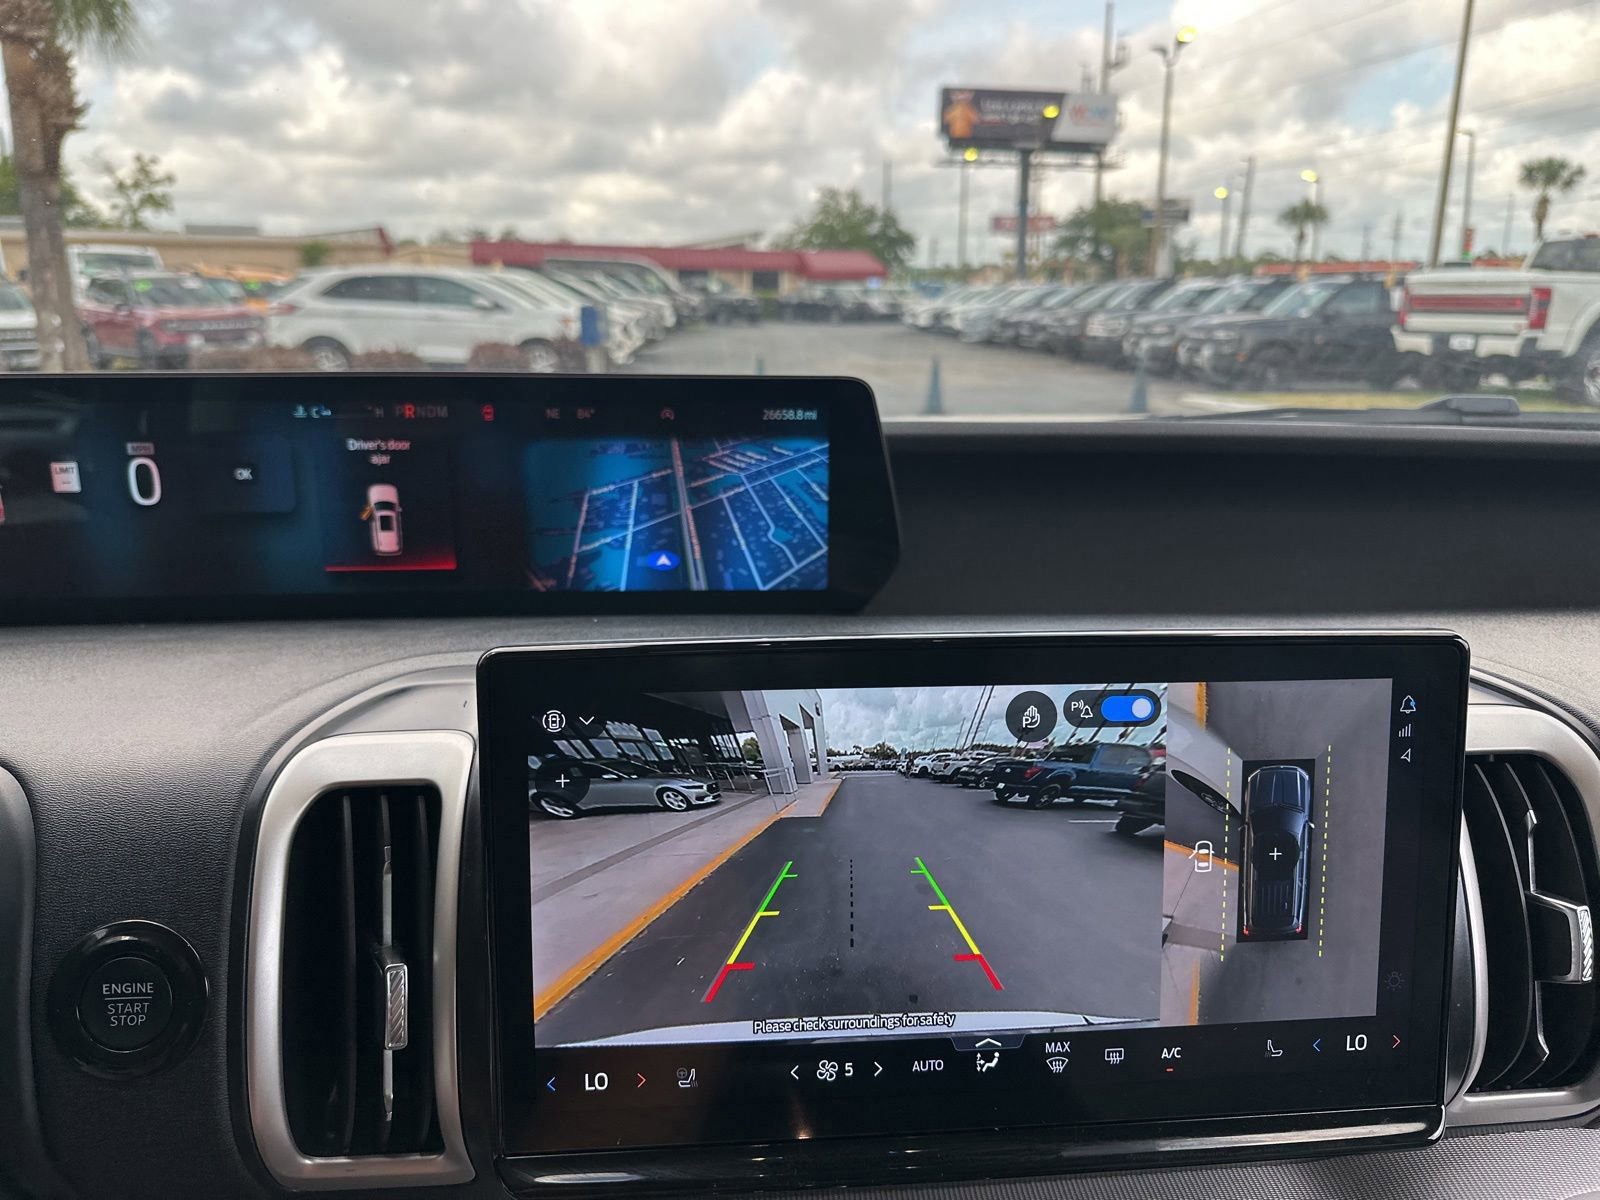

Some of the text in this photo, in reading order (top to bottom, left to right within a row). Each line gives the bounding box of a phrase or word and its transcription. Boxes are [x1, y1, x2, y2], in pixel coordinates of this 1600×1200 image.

[763, 409, 803, 421] 26658.8
[346, 438, 411, 451] Driver's door
[370, 454, 390, 467] ajar
[54, 466, 75, 475] LIMIT
[234, 467, 254, 481] OK
[128, 457, 161, 506] 0
[102, 982, 155, 995] ENGINE
[107, 1003, 150, 1015] START
[110, 1015, 147, 1027] STOP
[753, 1013, 956, 1034] Please check surroundings for safety
[1045, 1042, 1070, 1054] MAX
[1345, 1034, 1368, 1052] LO
[1161, 1047, 1181, 1060] A/C
[844, 1062, 854, 1077] 5
[912, 1059, 944, 1073] AUTO
[584, 1072, 609, 1091] LO
